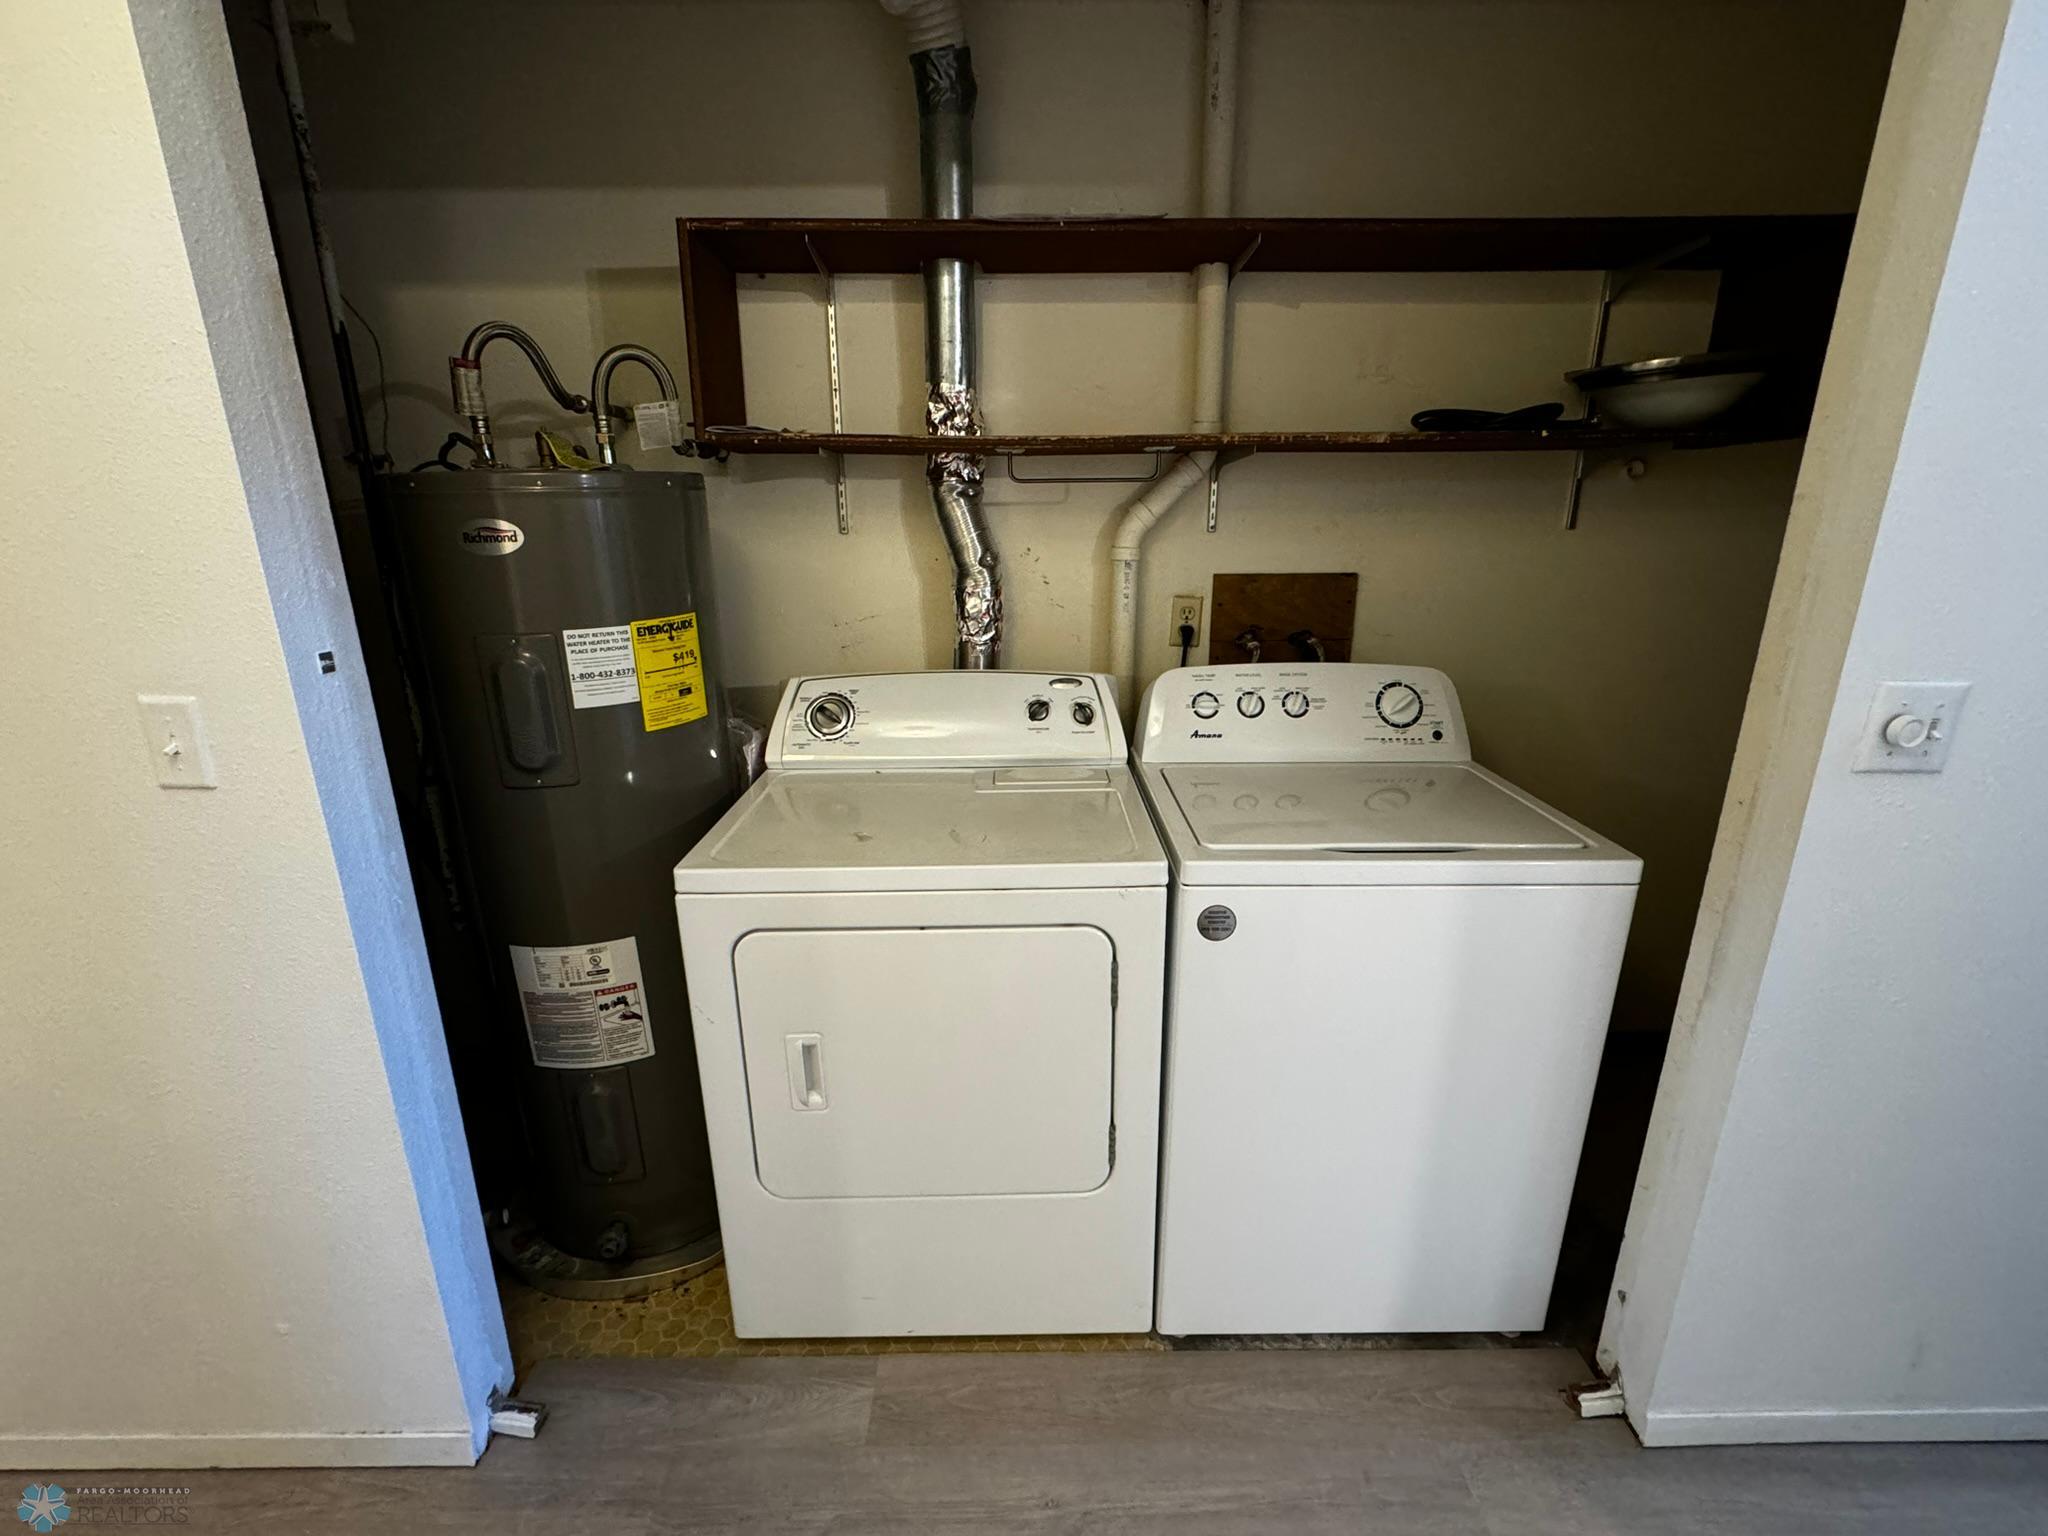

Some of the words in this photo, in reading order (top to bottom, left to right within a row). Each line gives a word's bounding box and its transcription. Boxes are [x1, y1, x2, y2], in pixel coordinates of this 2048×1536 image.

[462, 530, 518, 544] Richmond
[599, 645, 629, 653] PURCHASE
[571, 667, 636, 681] 1-800-432-8373
[1190, 729, 1223, 740] Amana
